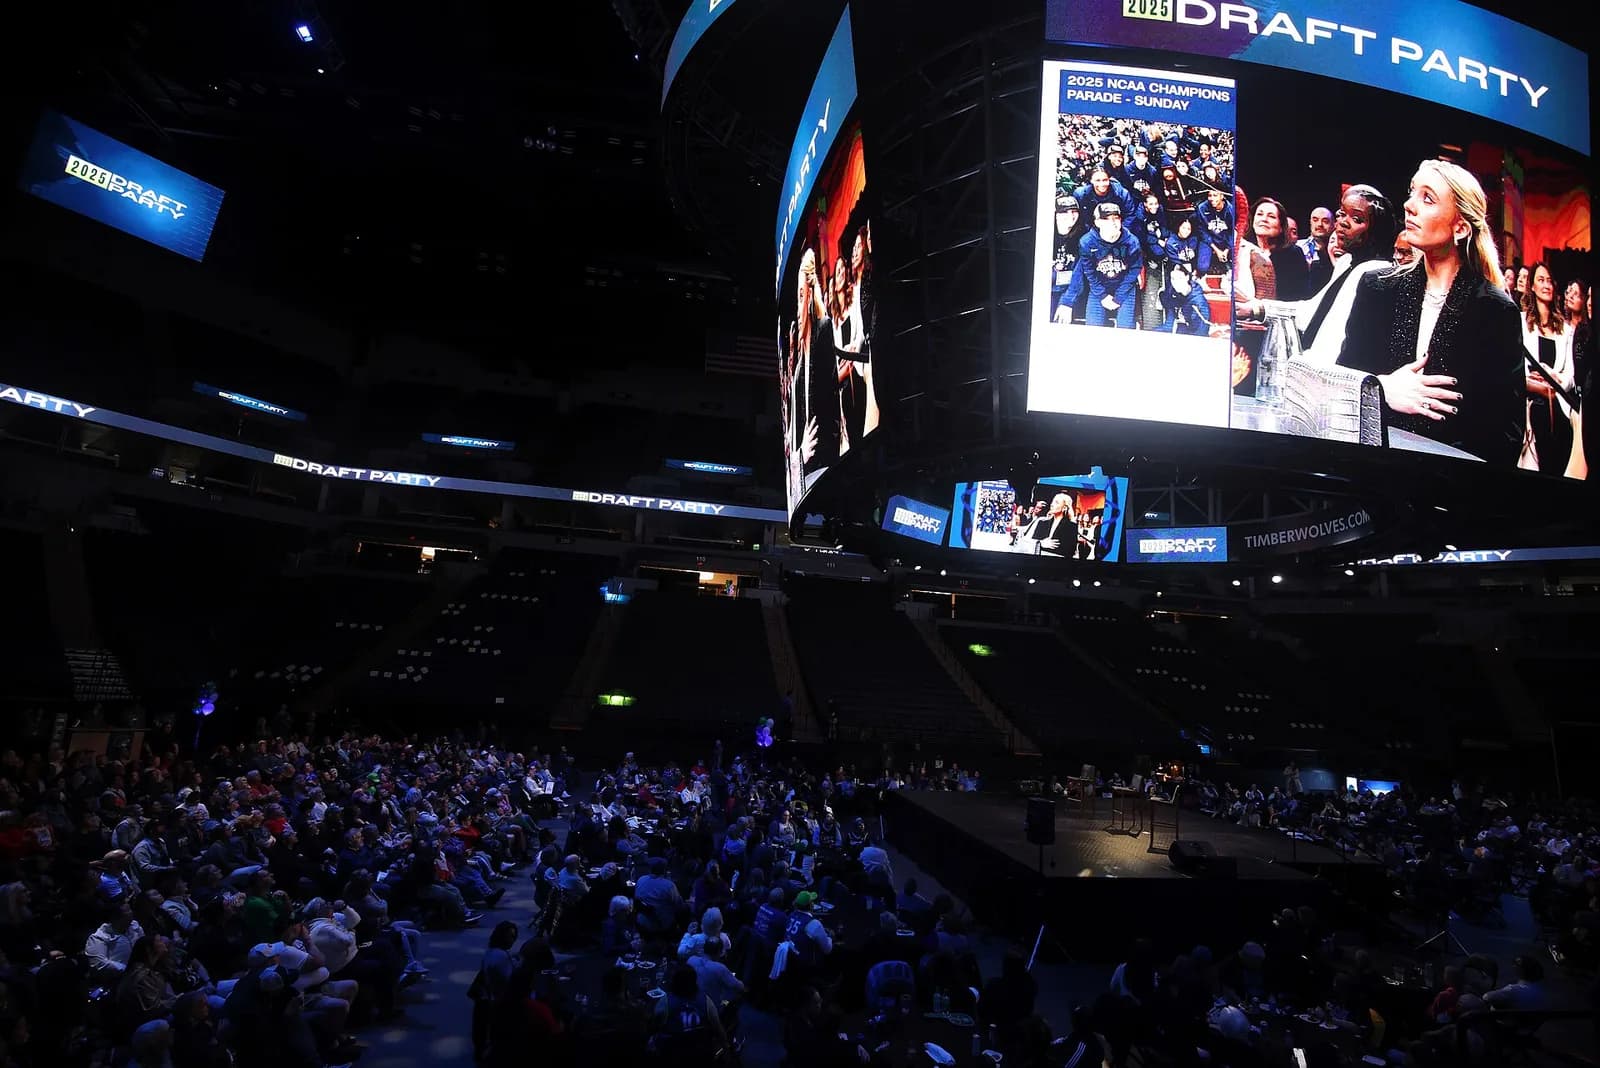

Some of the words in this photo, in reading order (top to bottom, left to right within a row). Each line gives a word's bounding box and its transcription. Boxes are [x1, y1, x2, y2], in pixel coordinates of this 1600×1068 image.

[1127, 0, 1169, 17] 2025
[1176, 0, 1377, 56] DRAFT
[1391, 36, 1549, 108] PARTY
[1067, 75, 1104, 87] 2025
[1107, 77, 1146, 92] NCAA
[1149, 82, 1231, 102] CHAMPIONS
[1067, 89, 1122, 104] PARADE
[1134, 94, 1190, 111] SUNDAY
[71, 160, 106, 184] 2025
[110, 174, 187, 211] DRAFT
[108, 183, 184, 219] PARTY
[0, 387, 96, 417] ARTY
[292, 457, 366, 480] DRAFT
[369, 470, 440, 487] PARTY
[588, 492, 655, 508] DRAFT
[658, 499, 724, 515] PARTY
[910, 512, 942, 527] DRAFT
[1244, 510, 1371, 548] TIMBERWOLVES.COM
[1165, 538, 1217, 546] DRAFT
[1165, 545, 1217, 553] PARTY
